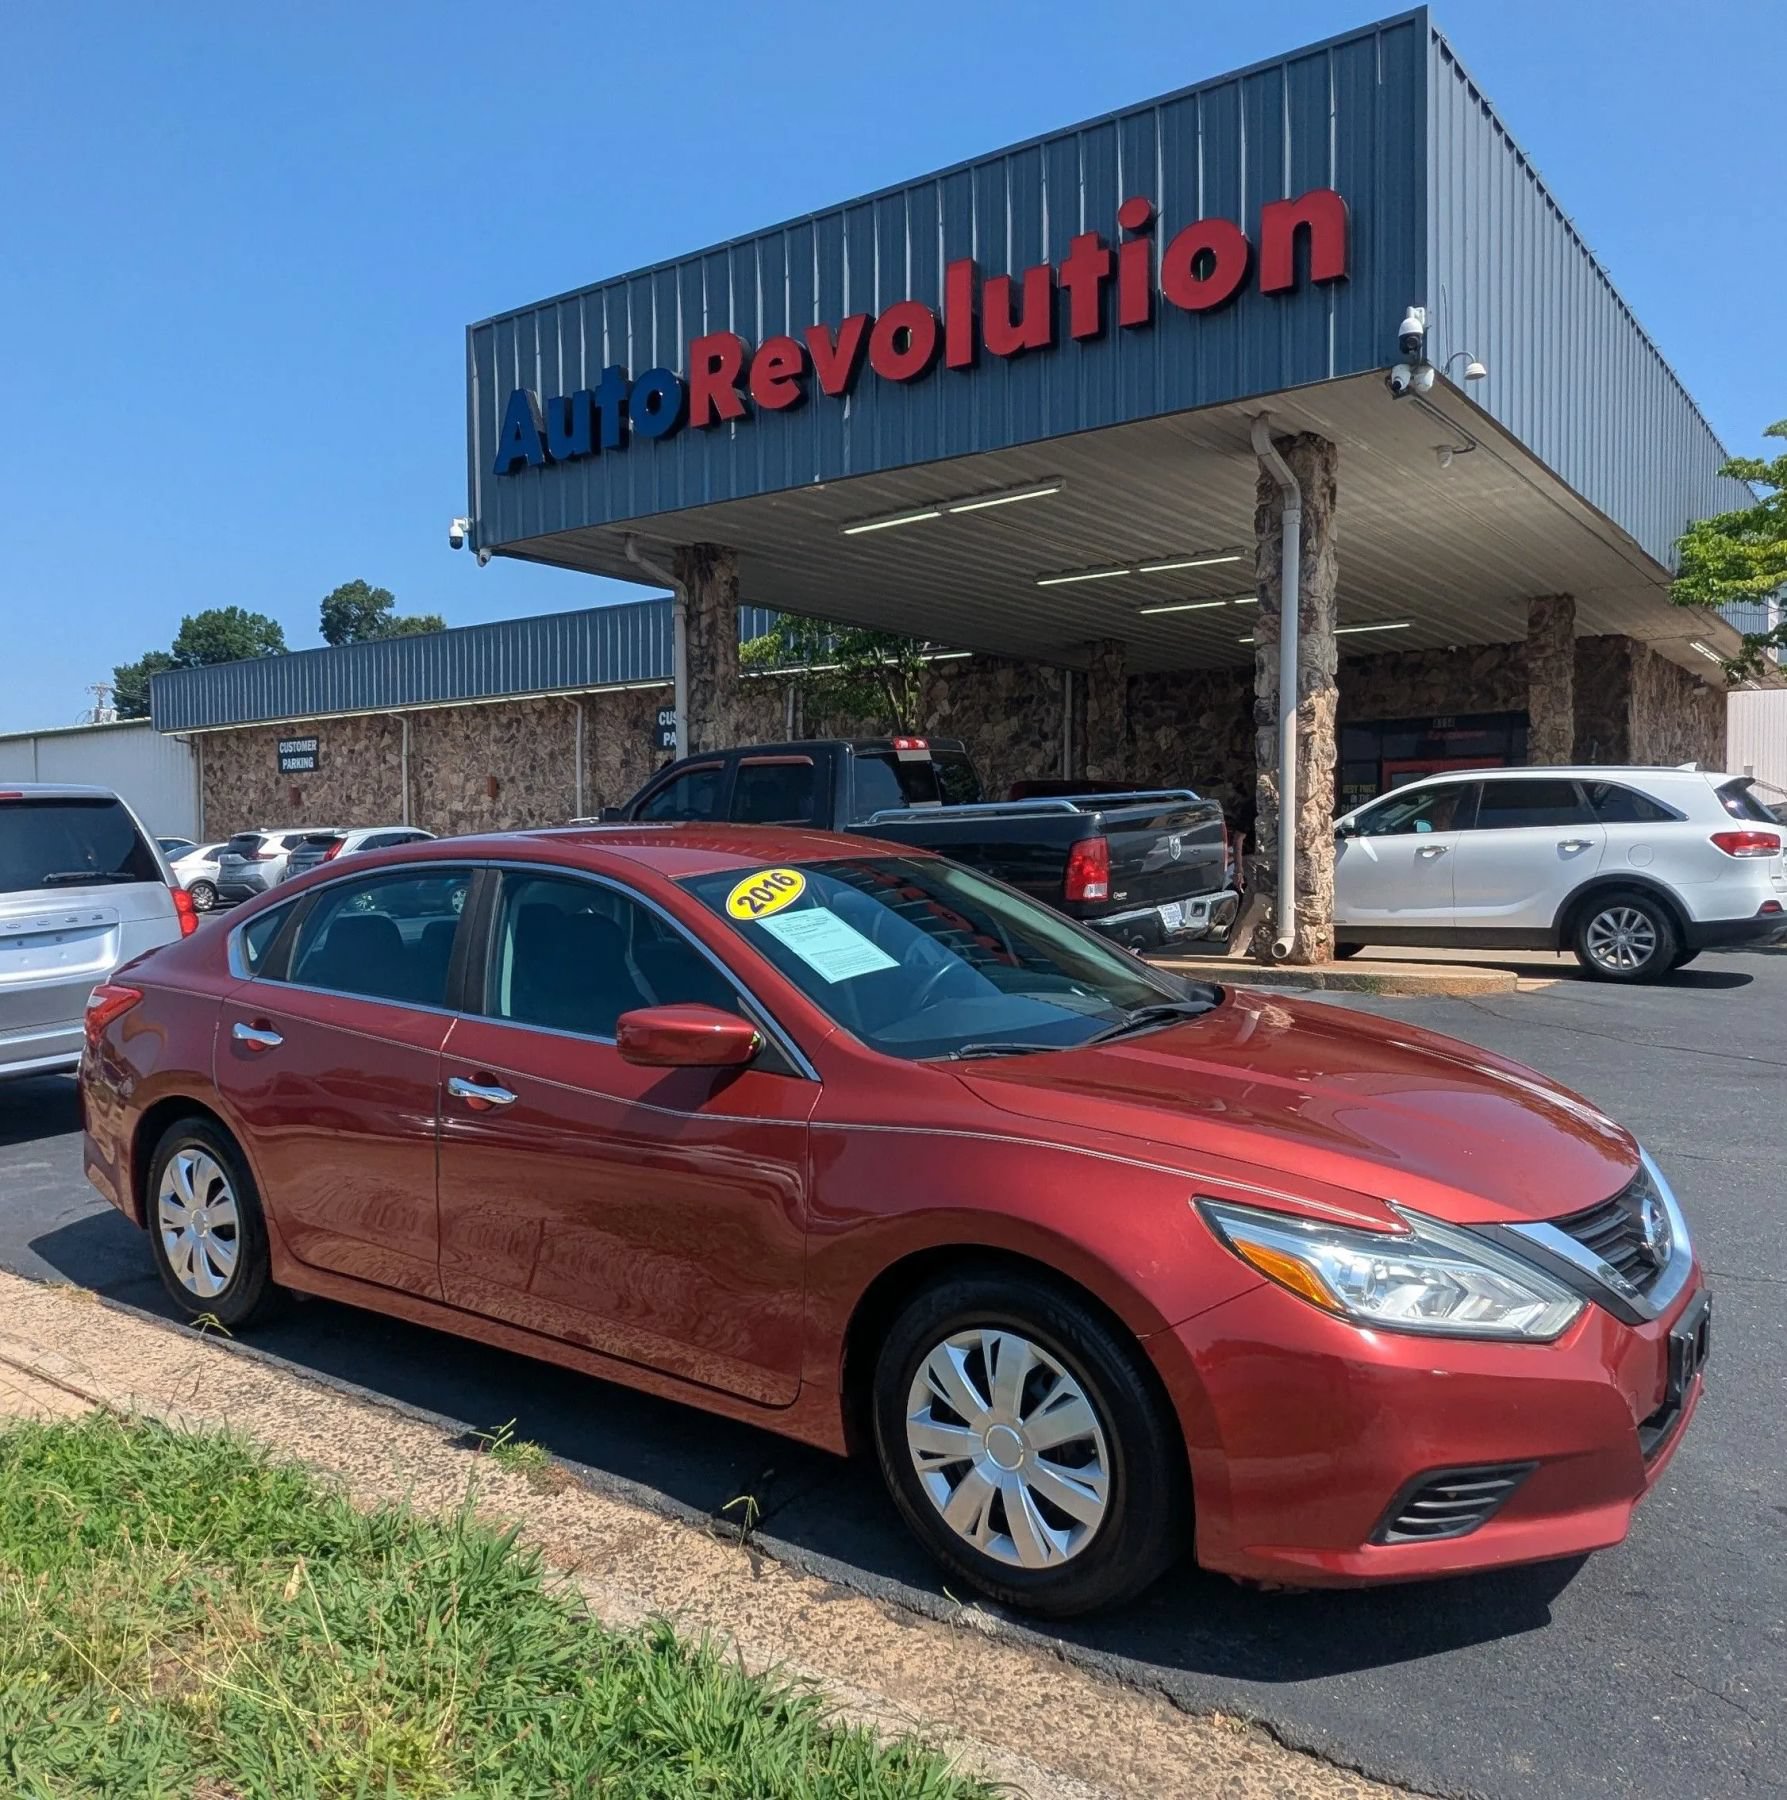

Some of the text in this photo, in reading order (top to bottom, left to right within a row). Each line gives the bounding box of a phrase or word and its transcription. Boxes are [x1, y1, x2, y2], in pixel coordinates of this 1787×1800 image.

[279, 740, 317, 753] CUSTOMER
[282, 756, 314, 770] PARKING
[736, 872, 796, 915] 2016
